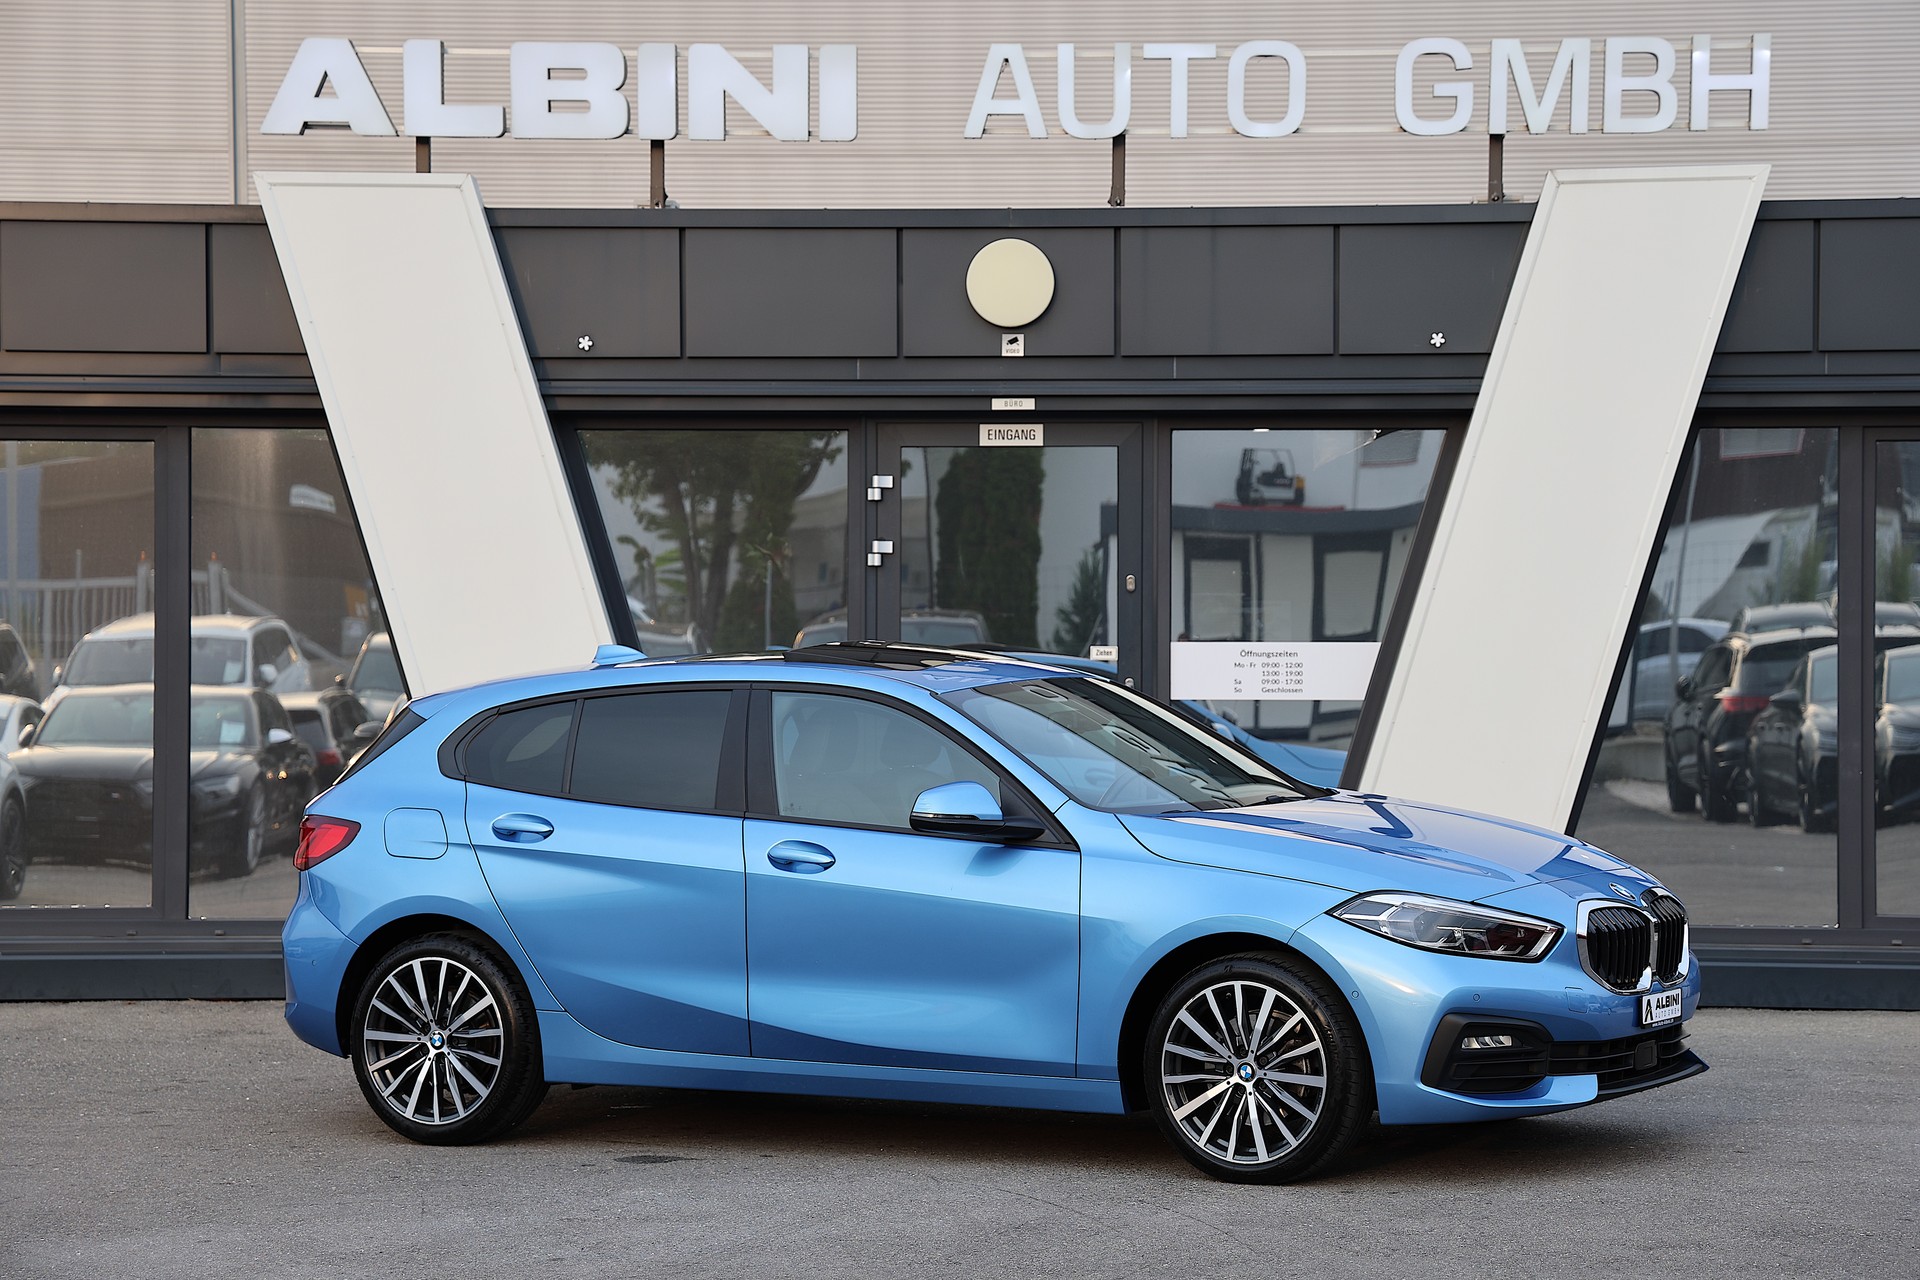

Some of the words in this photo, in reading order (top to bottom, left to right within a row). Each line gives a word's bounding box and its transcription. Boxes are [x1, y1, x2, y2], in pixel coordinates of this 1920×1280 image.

[260, 37, 859, 143] ALBINI
[964, 39, 1306, 139] AUTO
[1395, 32, 1772, 137] GMBH
[1004, 399, 1024, 408] BÜRO
[987, 428, 1036, 441] EINGANG
[1239, 648, 1299, 659] Öffnungszeiten
[1655, 993, 1680, 1010] ALBINI
